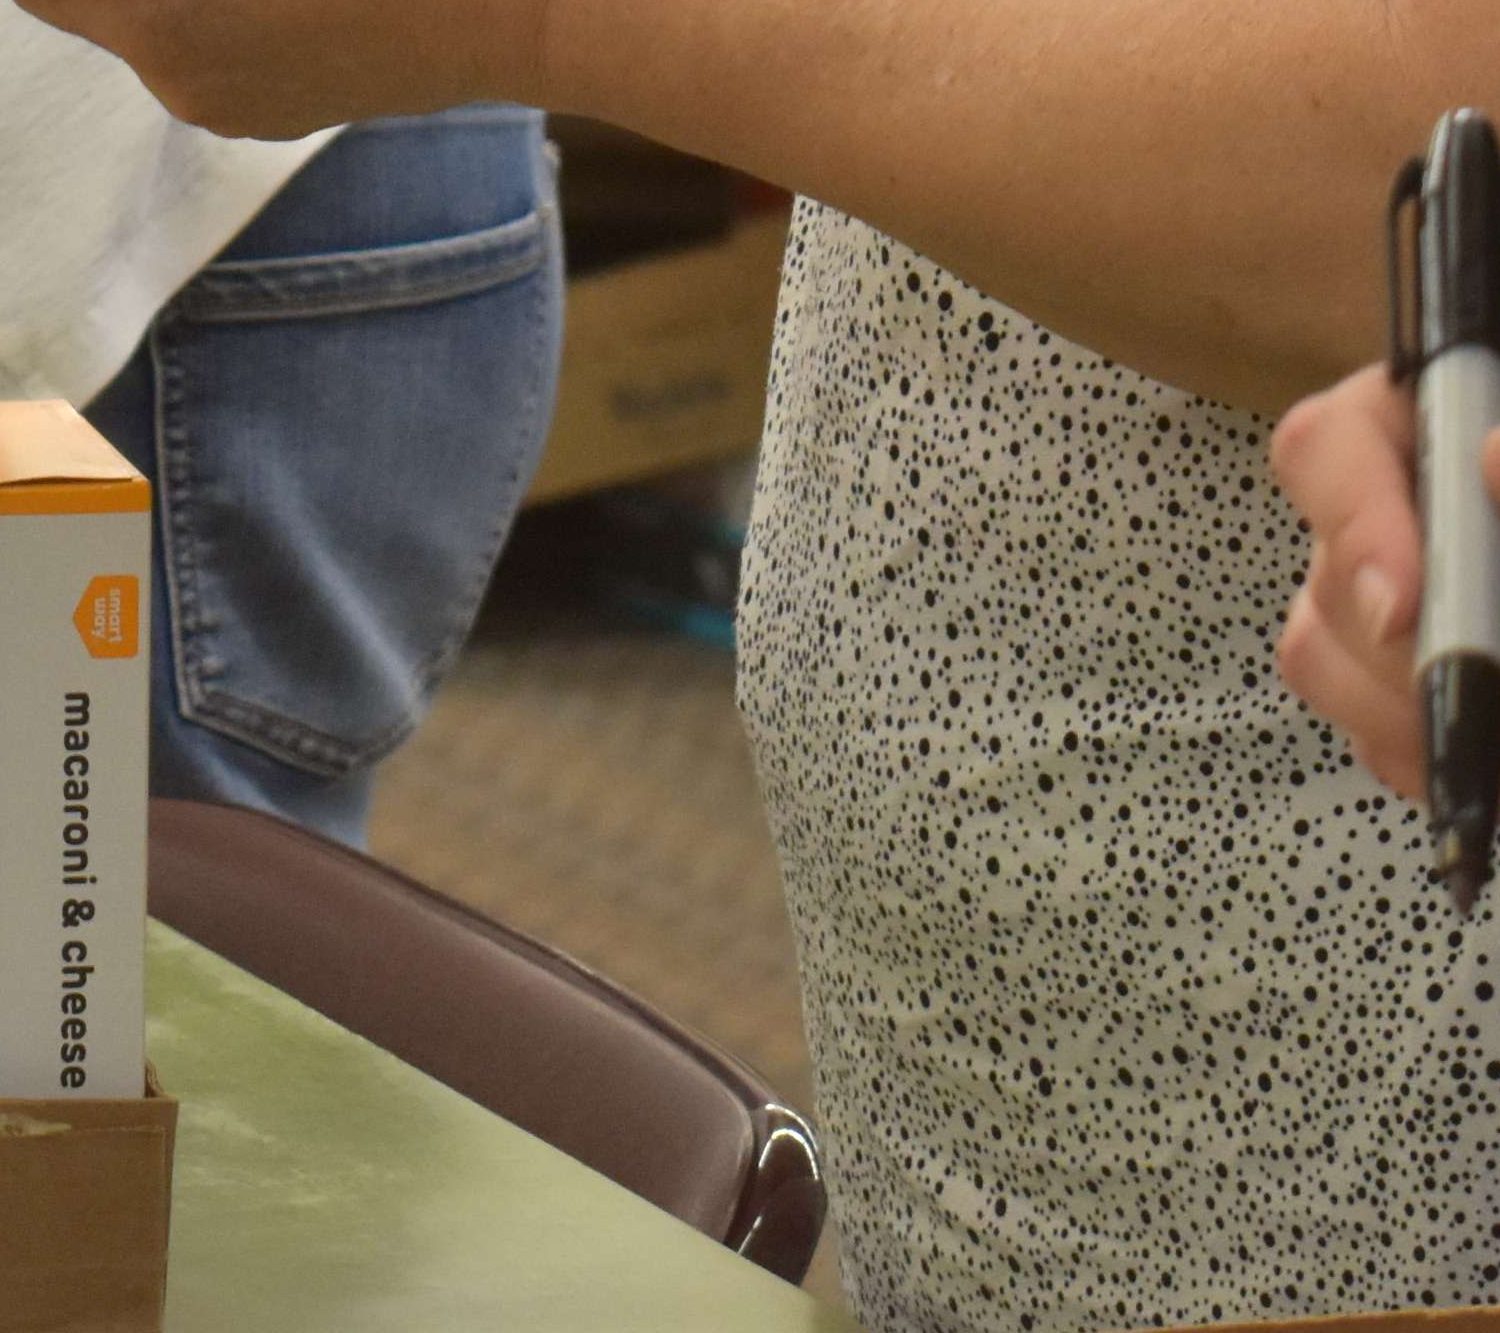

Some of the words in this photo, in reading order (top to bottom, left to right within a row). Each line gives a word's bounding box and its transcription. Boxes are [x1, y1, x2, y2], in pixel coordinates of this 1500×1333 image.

[109, 587, 122, 642] smart
[62, 690, 99, 886] macaroni
[61, 898, 95, 928] &
[60, 939, 94, 1090] cheese
